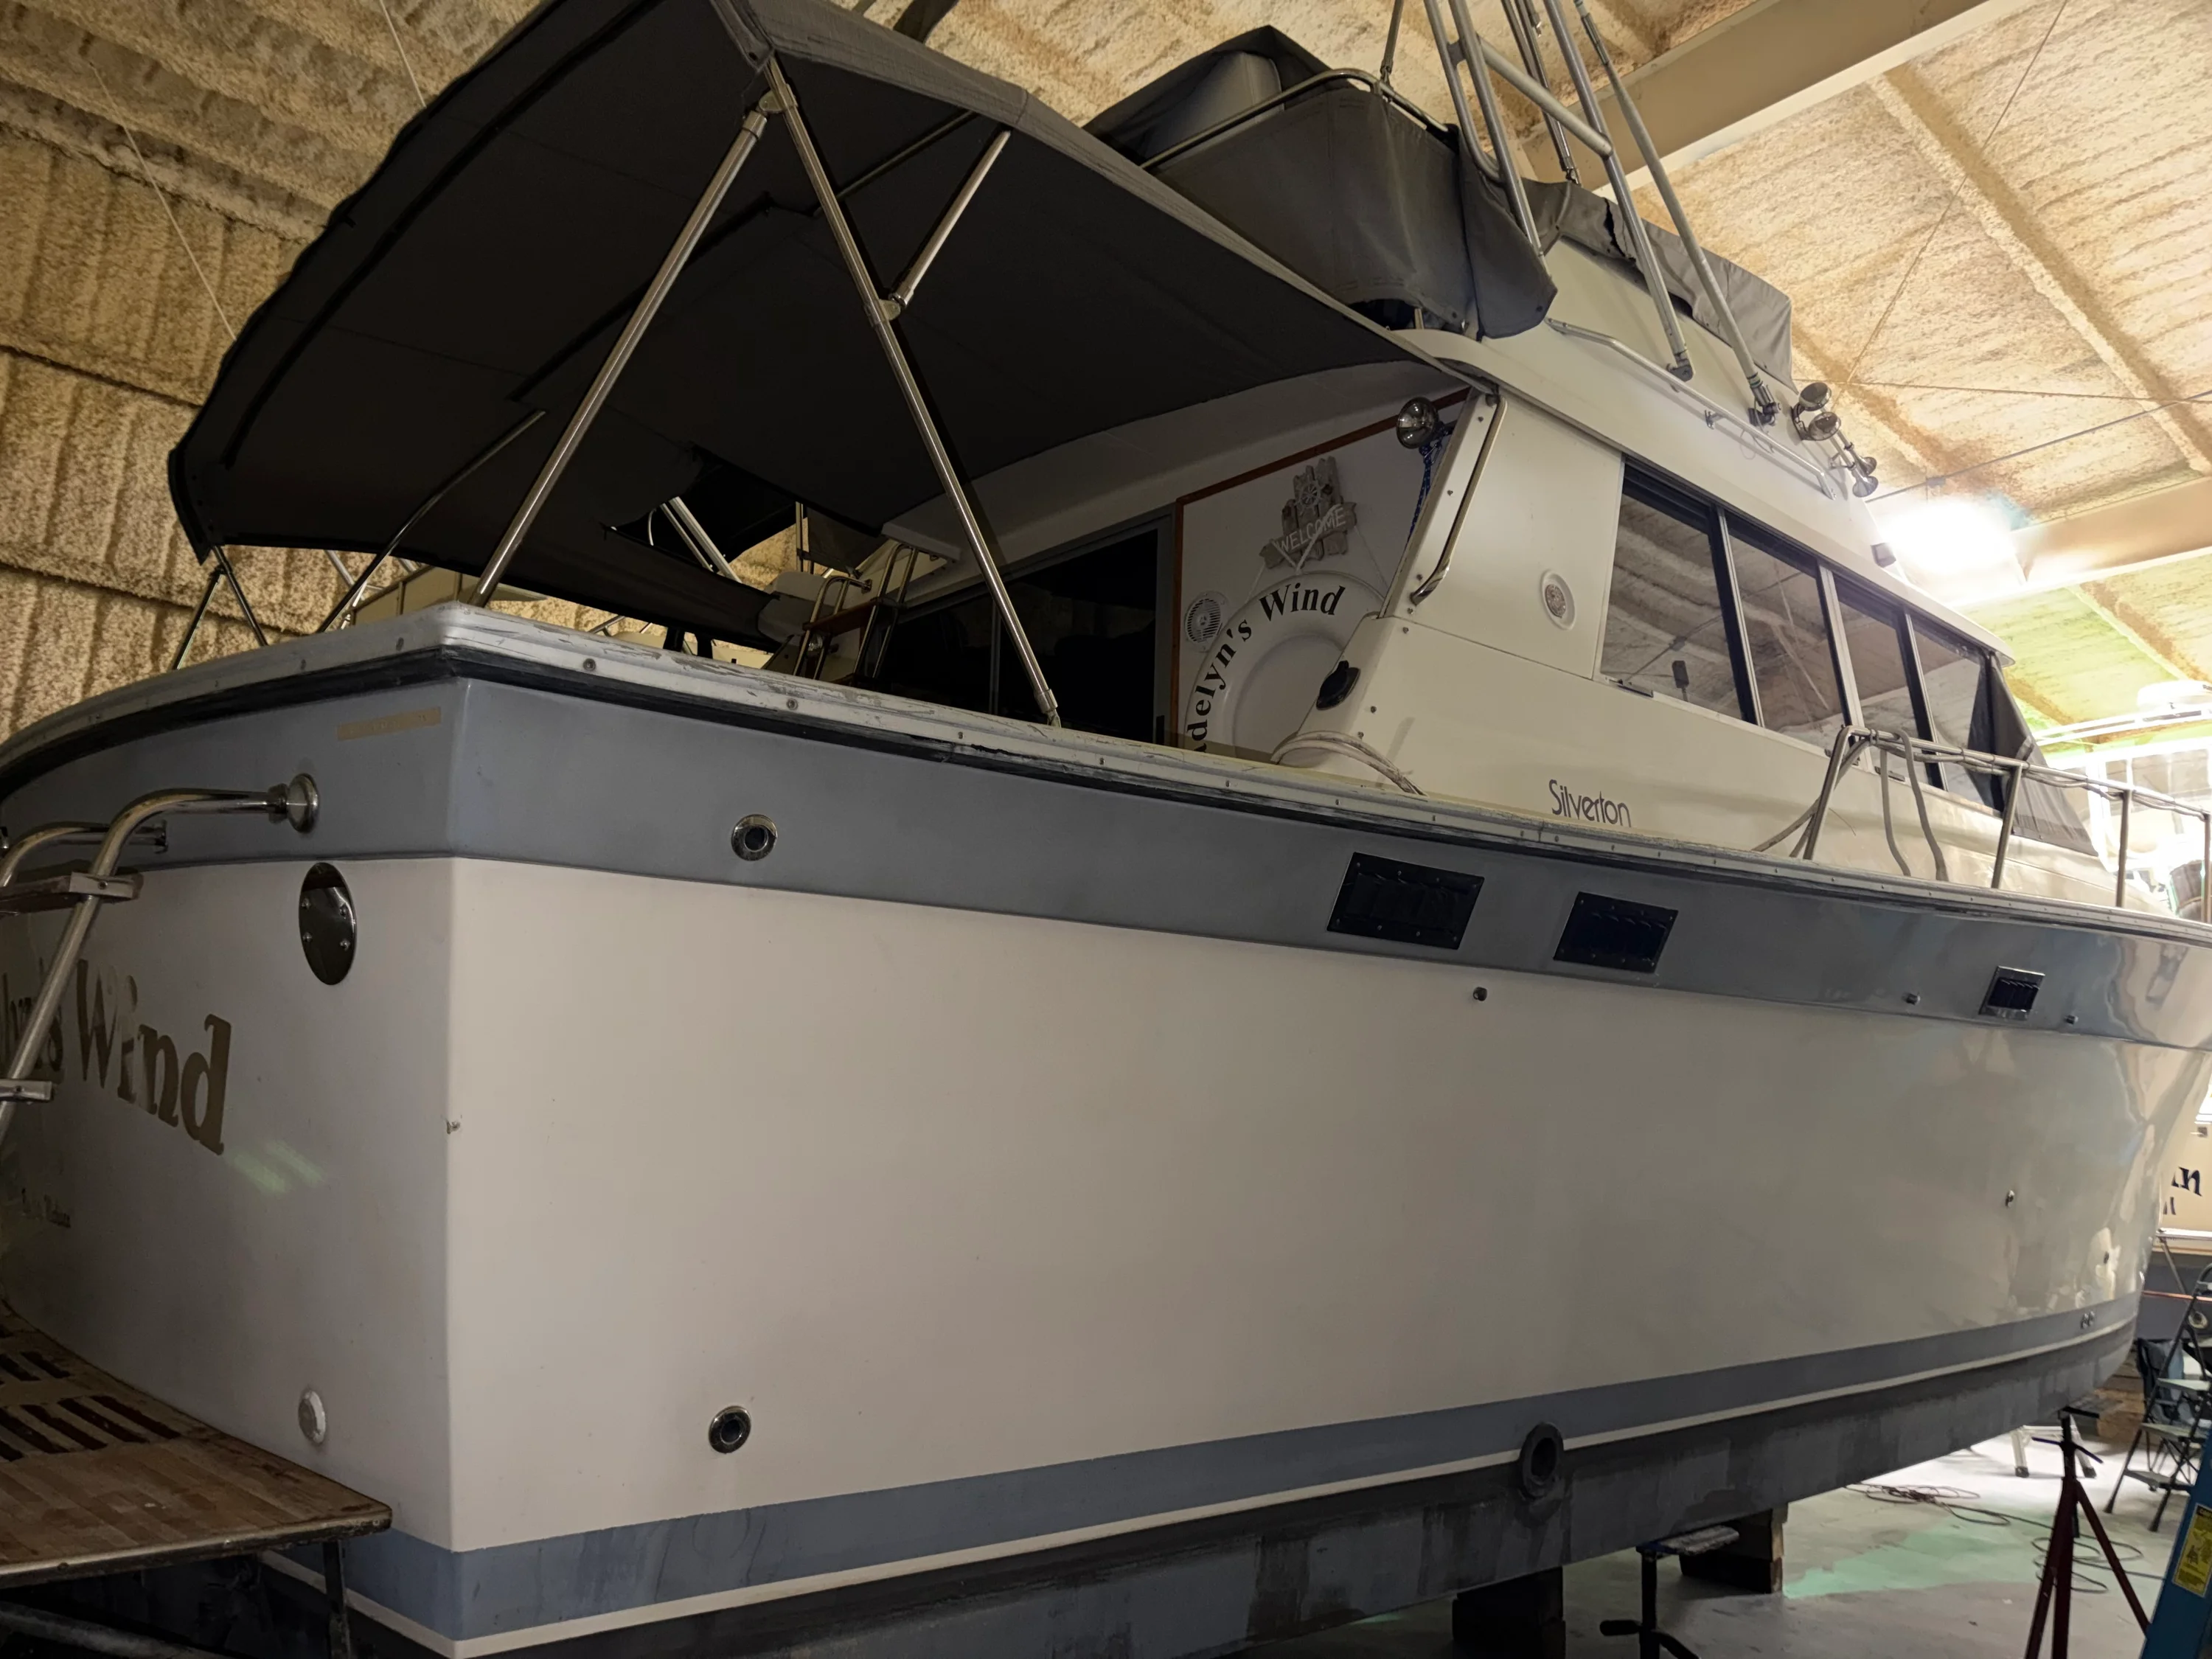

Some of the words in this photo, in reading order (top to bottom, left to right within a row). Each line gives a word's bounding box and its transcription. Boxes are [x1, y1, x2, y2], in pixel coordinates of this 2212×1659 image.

[1275, 506, 1346, 553] WELCOME
[1258, 582, 1346, 622] Wind
[1548, 779, 1632, 828] Silverton
[76, 959, 232, 1156] Wind
